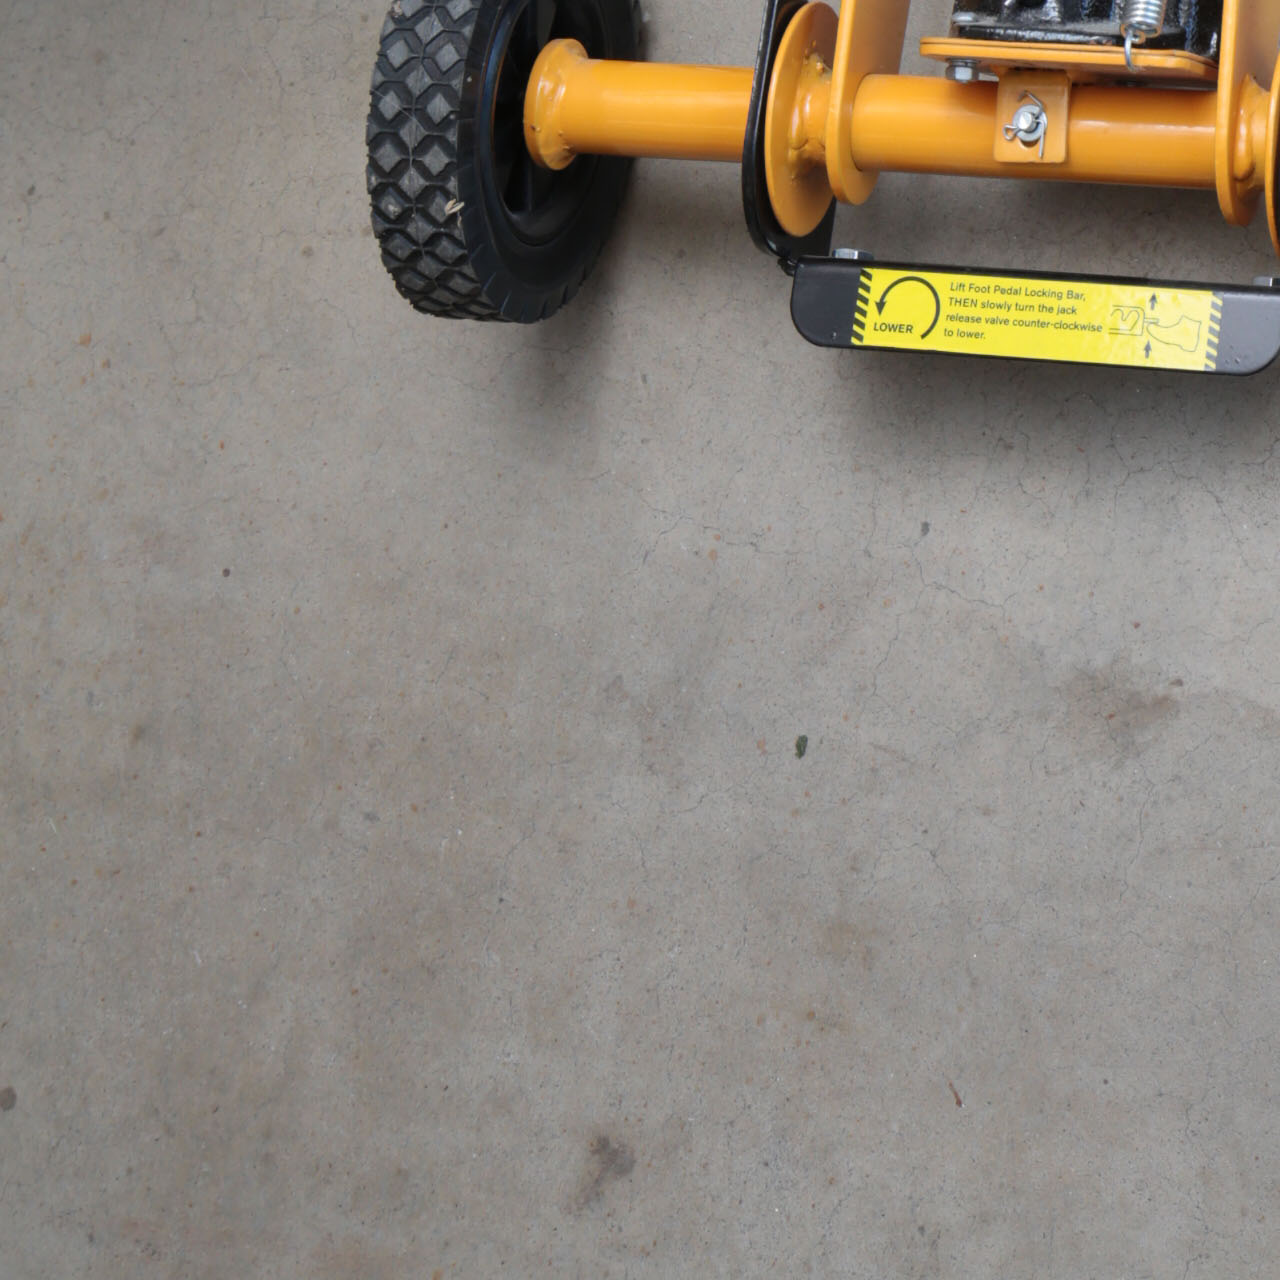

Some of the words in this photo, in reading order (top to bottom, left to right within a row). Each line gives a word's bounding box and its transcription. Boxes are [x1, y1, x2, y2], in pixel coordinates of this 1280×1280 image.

[950, 282, 966, 292] Lift
[968, 284, 990, 294] Foot
[994, 284, 1021, 296] Pedal
[1025, 286, 1063, 300] Locking
[1066, 290, 1086, 302] Bar,
[949, 297, 978, 308] THEN
[981, 301, 1012, 312] slowly
[1015, 302, 1034, 312] turn
[1038, 303, 1054, 314] the
[1057, 304, 1077, 316] jack
[874, 322, 914, 334] LOWER
[946, 313, 982, 324] release
[985, 315, 1010, 326] valve
[1012, 318, 1102, 333] counter-clockwise
[944, 329, 954, 338] to
[957, 329, 985, 340] lower.
